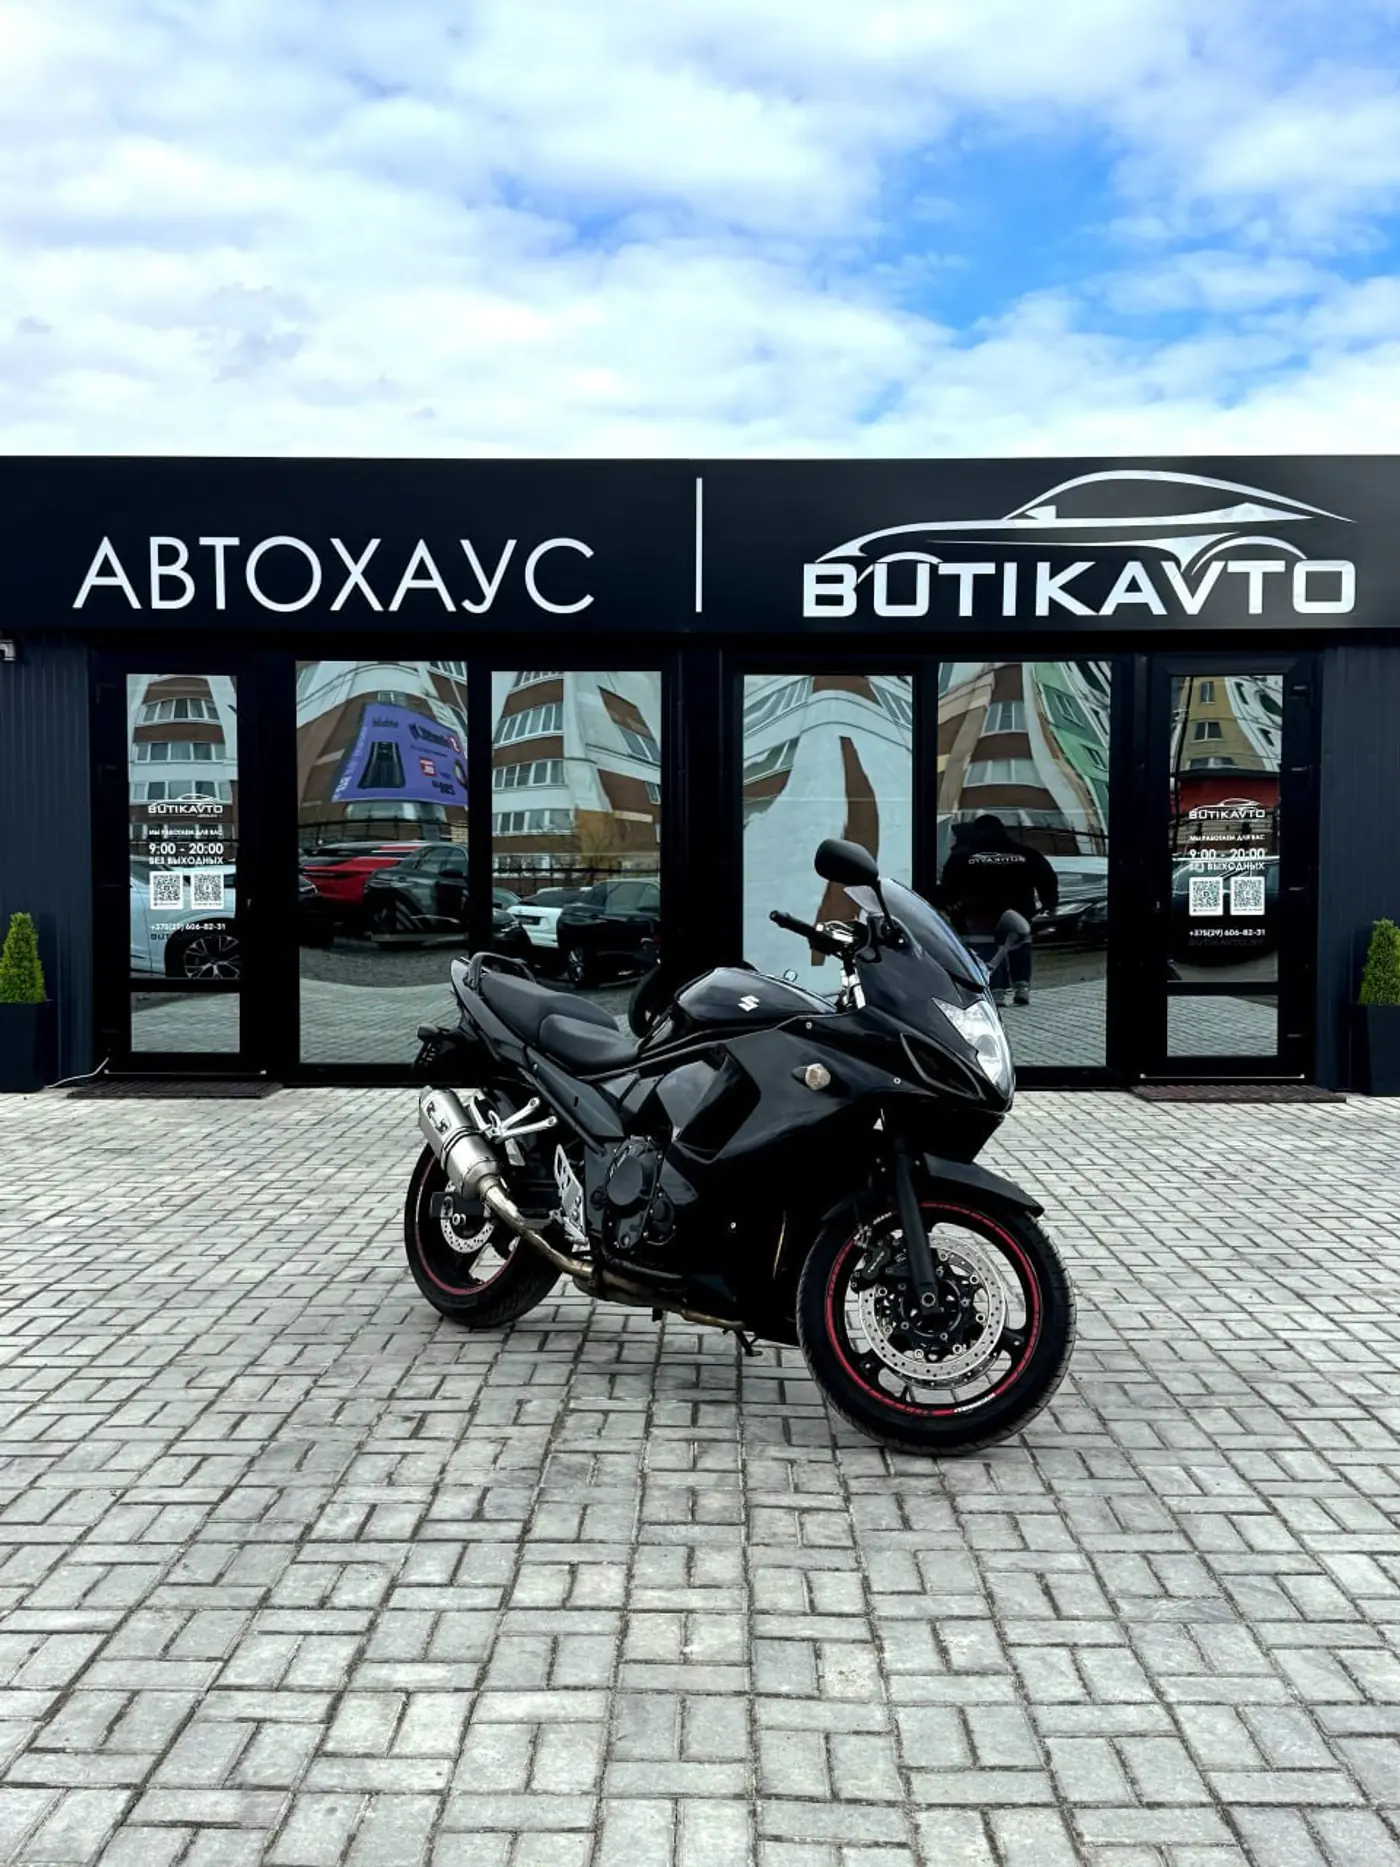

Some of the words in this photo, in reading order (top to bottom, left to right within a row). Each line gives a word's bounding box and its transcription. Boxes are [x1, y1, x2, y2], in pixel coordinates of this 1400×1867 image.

[73, 536, 594, 613] АВТОХАУС
[803, 560, 1356, 617] BUTIKAVTO
[148, 804, 223, 814] BUTIKAVTO
[1189, 809, 1265, 819] BUTIKAVTO
[148, 842, 176, 855] 9:00
[188, 842, 224, 855] 20:00
[1190, 848, 1217, 860] 9:00
[1229, 848, 1265, 860] 20:00
[167, 856, 223, 865] ВЫХОДНЫХ
[1224, 928, 1266, 937] 606-82-31
